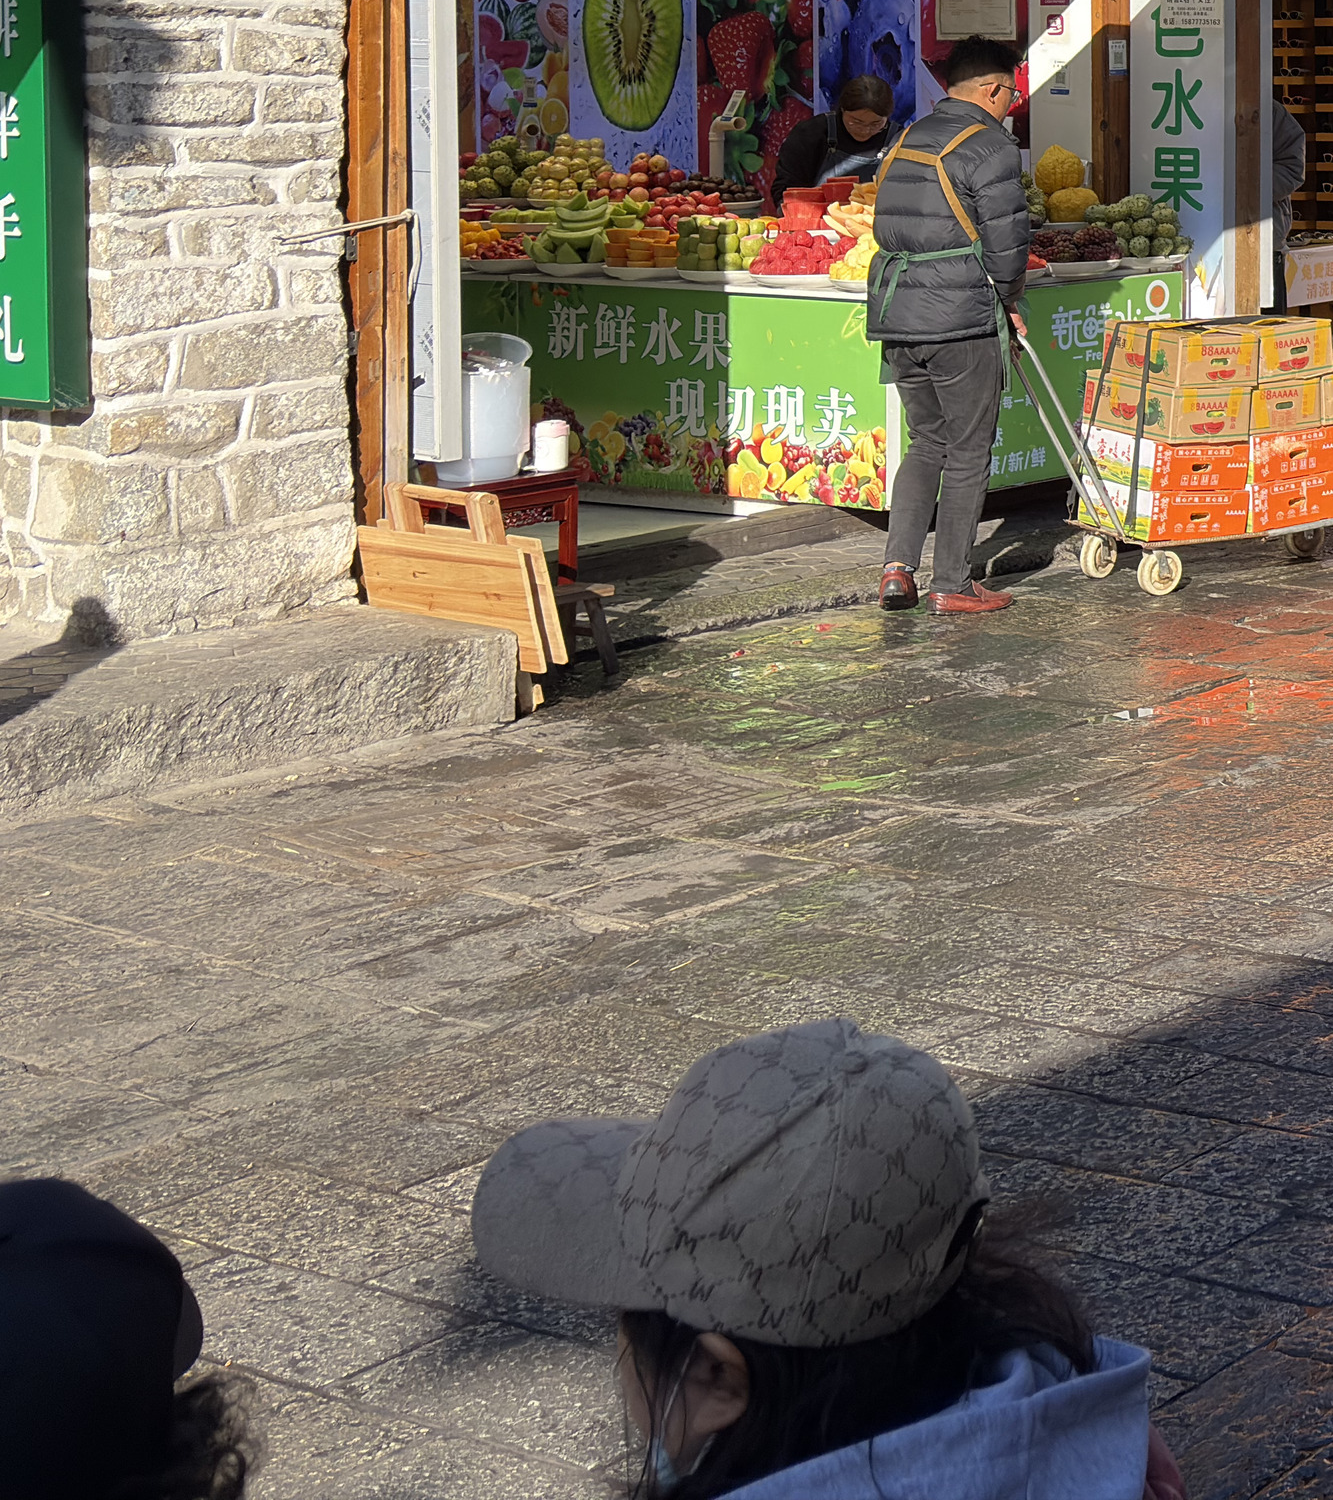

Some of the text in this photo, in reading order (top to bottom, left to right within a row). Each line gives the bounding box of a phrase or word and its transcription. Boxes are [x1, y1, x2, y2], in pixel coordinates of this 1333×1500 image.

[546, 300, 733, 371] 新鲜水果
[663, 377, 857, 451] 现切现卖
